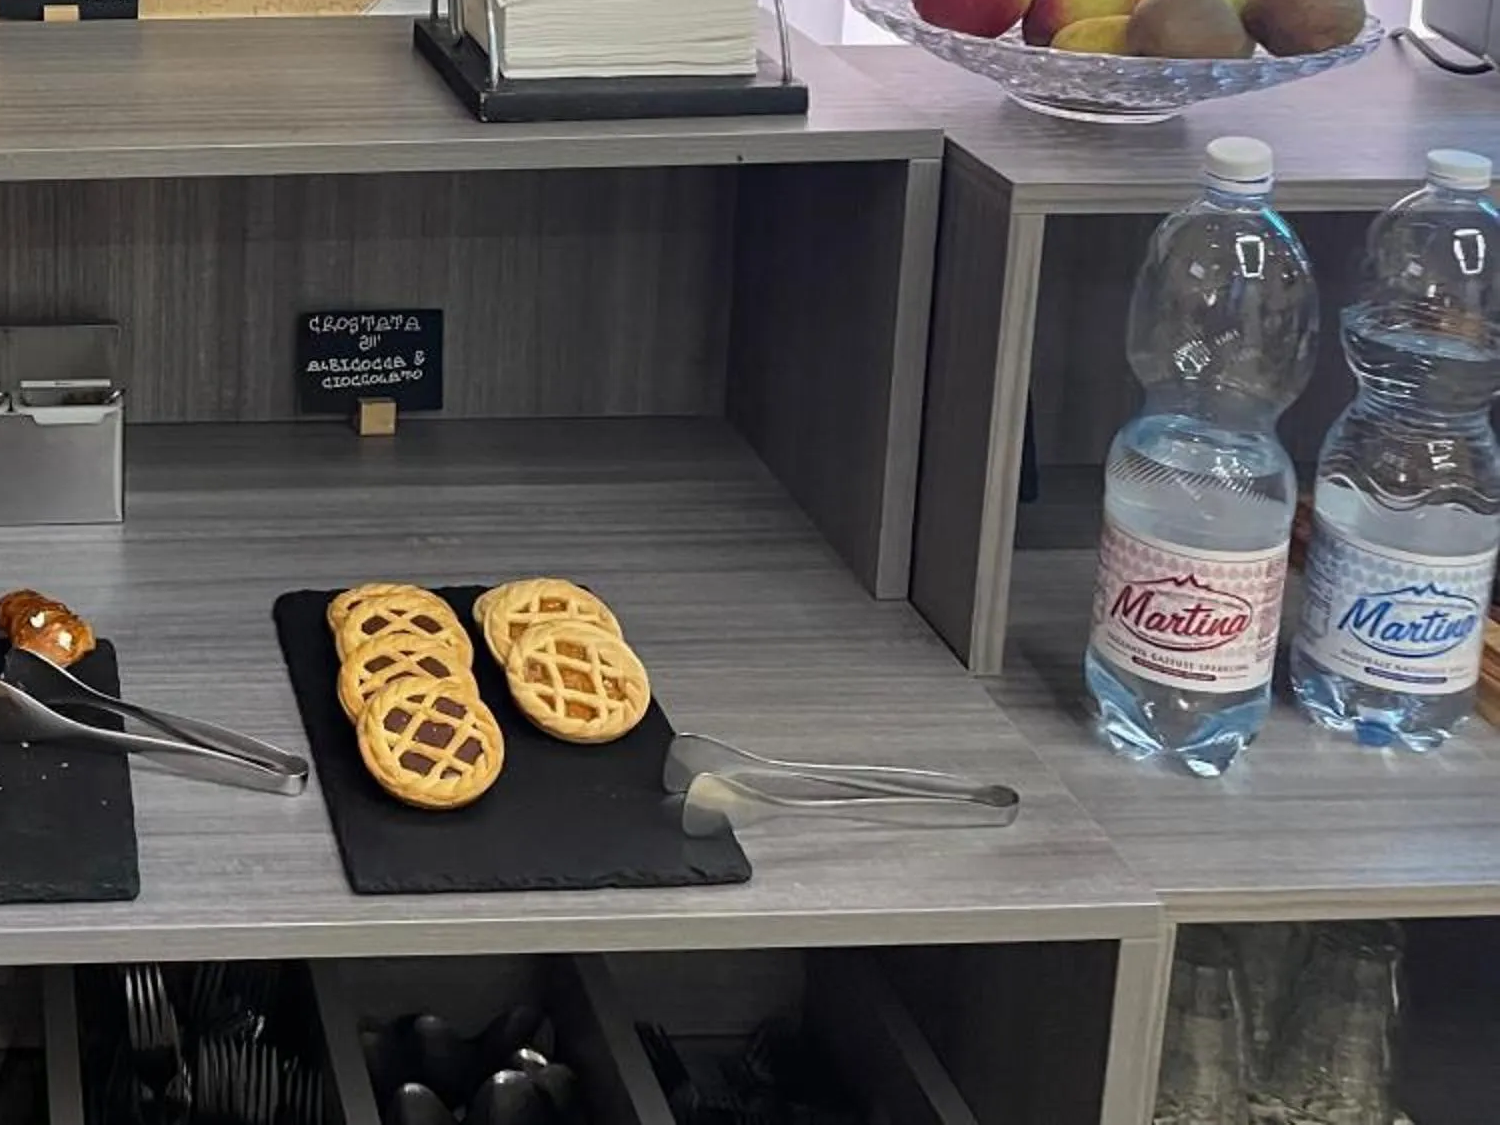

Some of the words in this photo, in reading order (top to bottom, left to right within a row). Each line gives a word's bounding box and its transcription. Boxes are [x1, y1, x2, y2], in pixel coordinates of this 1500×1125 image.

[309, 314, 422, 334] CROSTATA
[306, 355, 407, 373] ALBICOCCA
[321, 369, 424, 389] CIOCCOLATO
[1110, 584, 1250, 637] Martina
[1337, 597, 1478, 642] Martina
